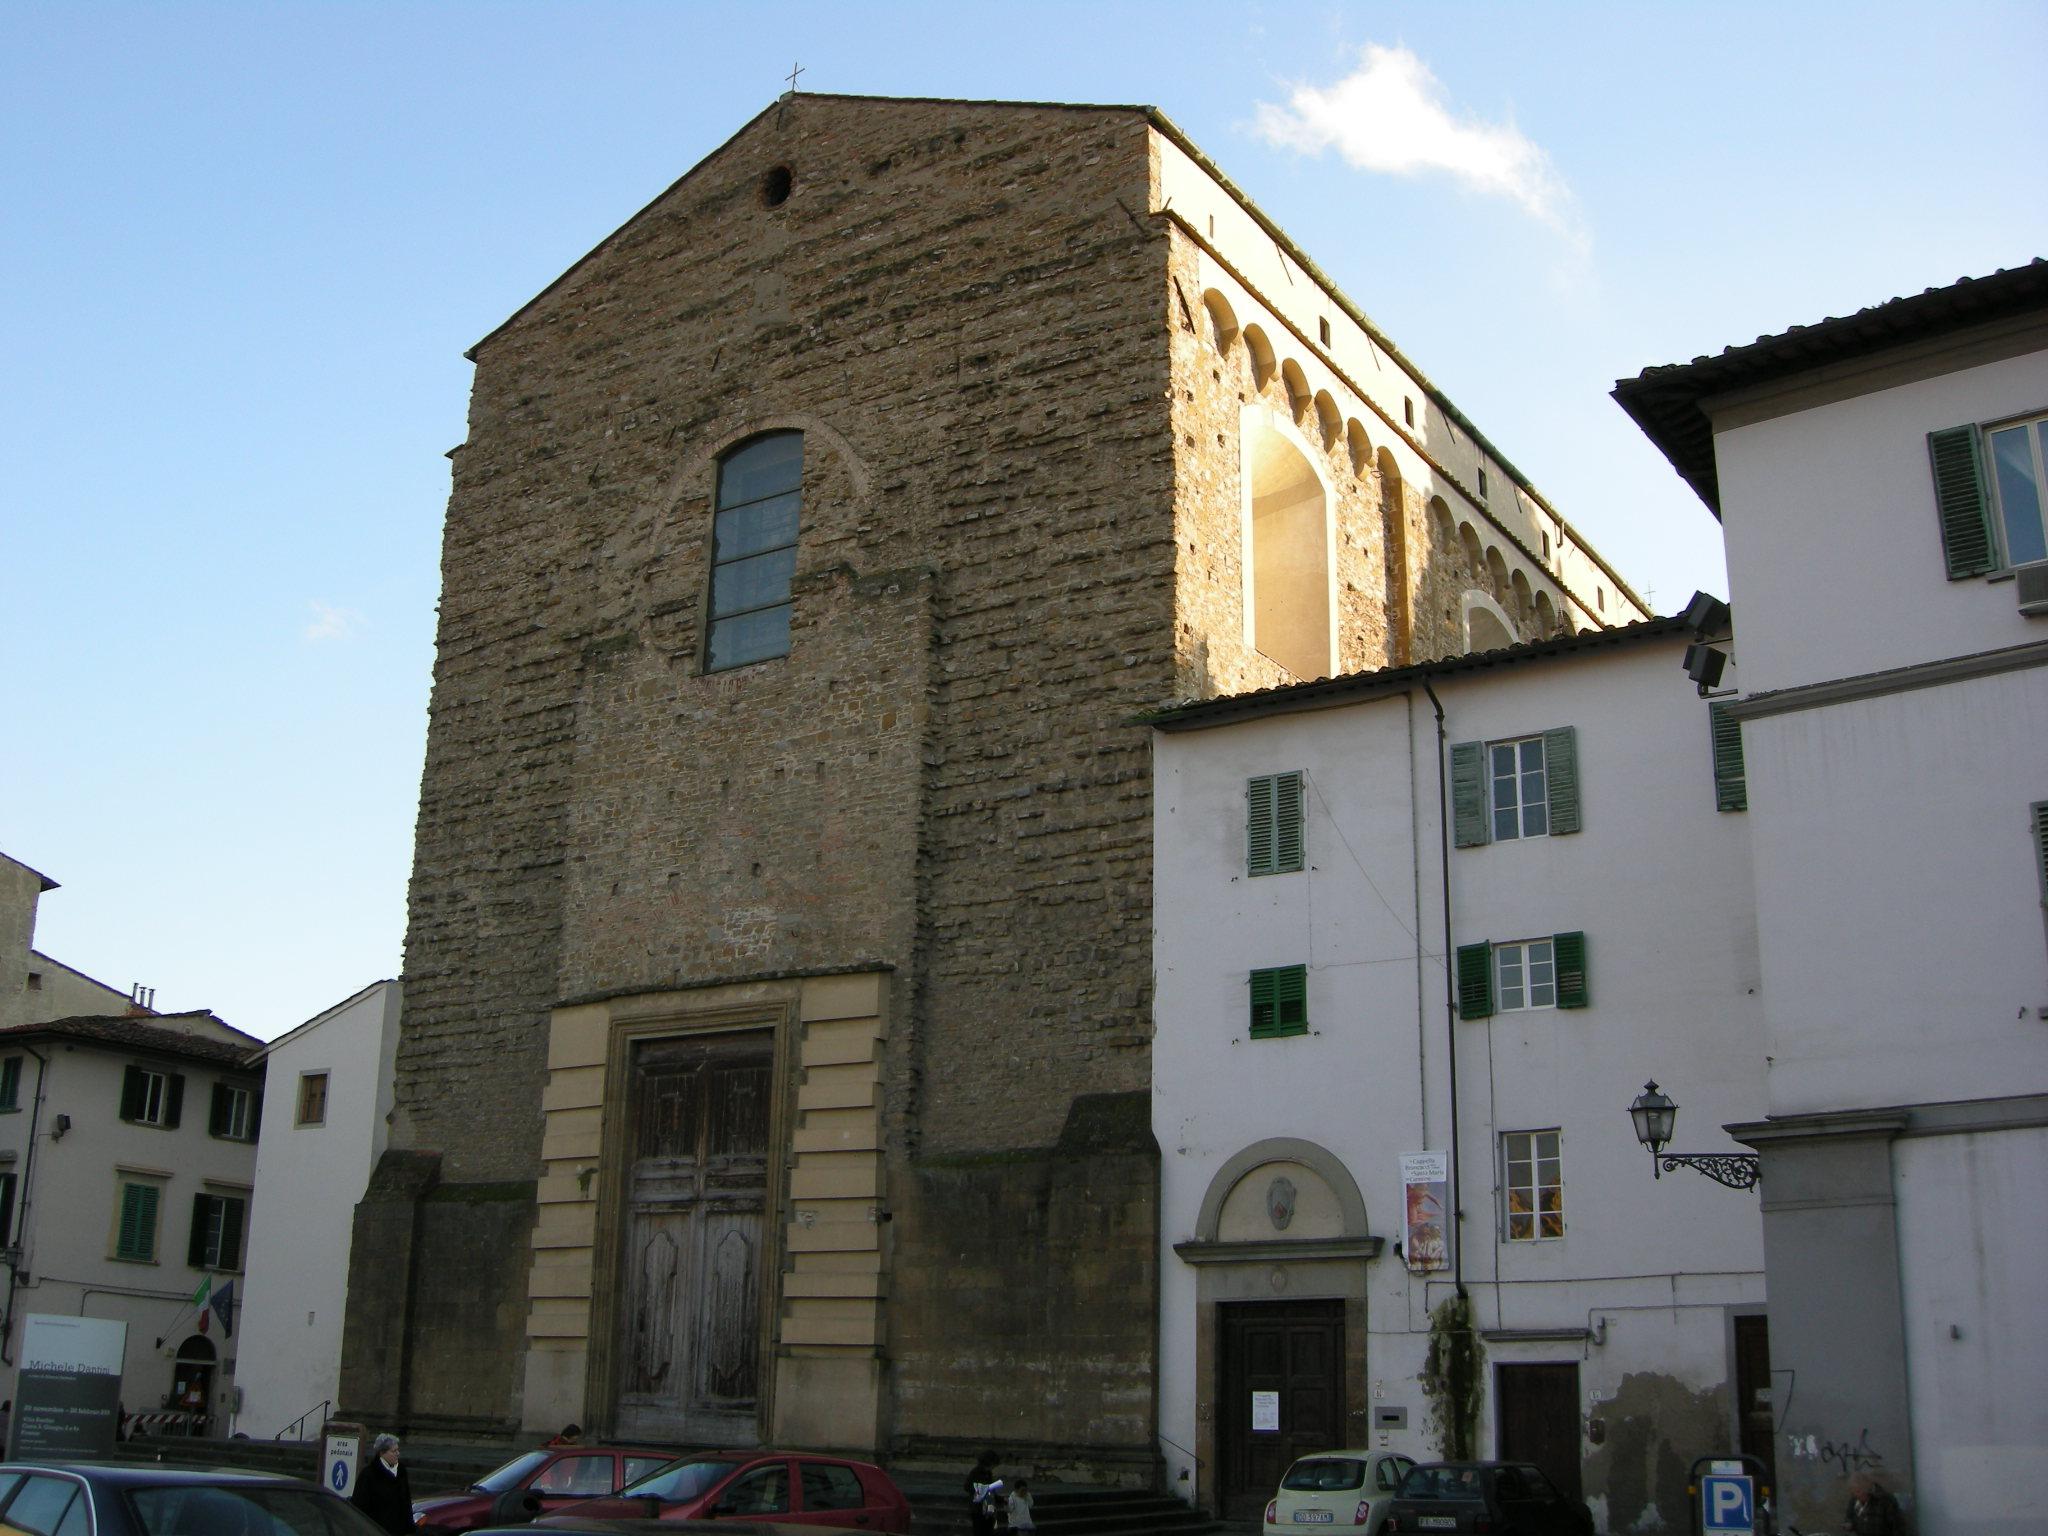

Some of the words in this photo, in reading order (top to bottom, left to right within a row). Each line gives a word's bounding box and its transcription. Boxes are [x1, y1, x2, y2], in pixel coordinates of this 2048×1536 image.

[29, 1360, 75, 1373] Michele
[330, 1448, 353, 1457] pedonale
[1712, 1481, 1743, 1524] P
